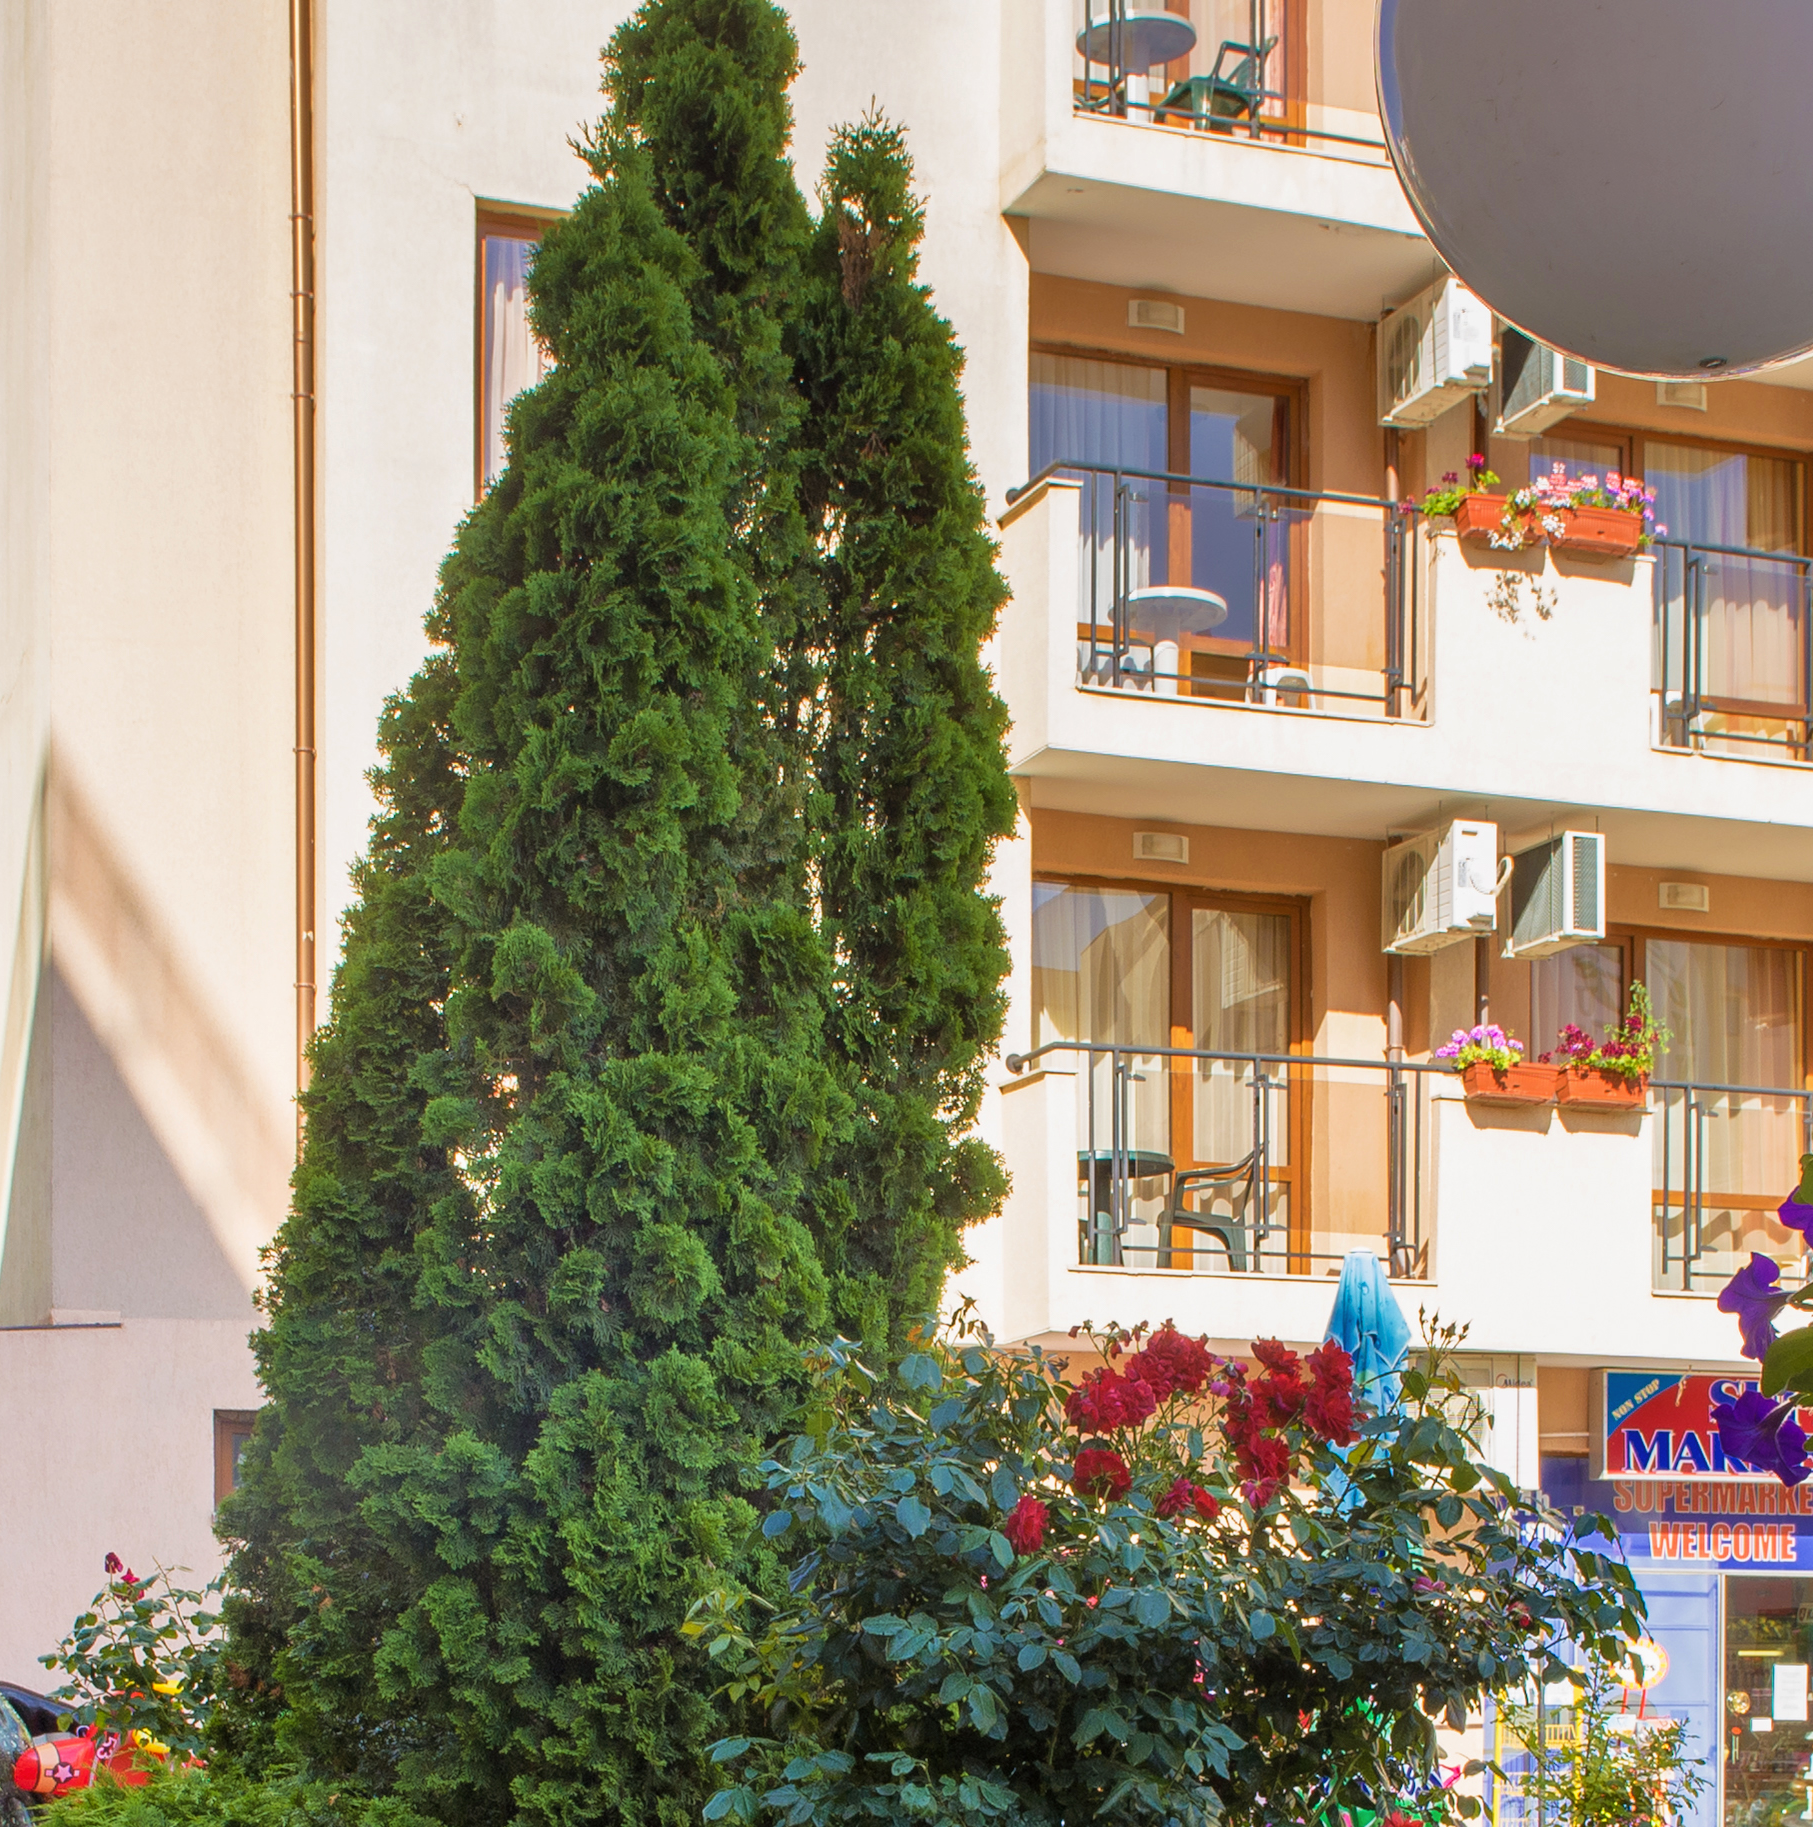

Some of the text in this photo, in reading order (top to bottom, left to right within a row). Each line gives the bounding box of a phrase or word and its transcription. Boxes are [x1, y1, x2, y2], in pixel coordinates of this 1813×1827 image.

[1611, 1379, 1659, 1420] NON STOP
[1648, 1521, 1797, 1562] WELCOME
